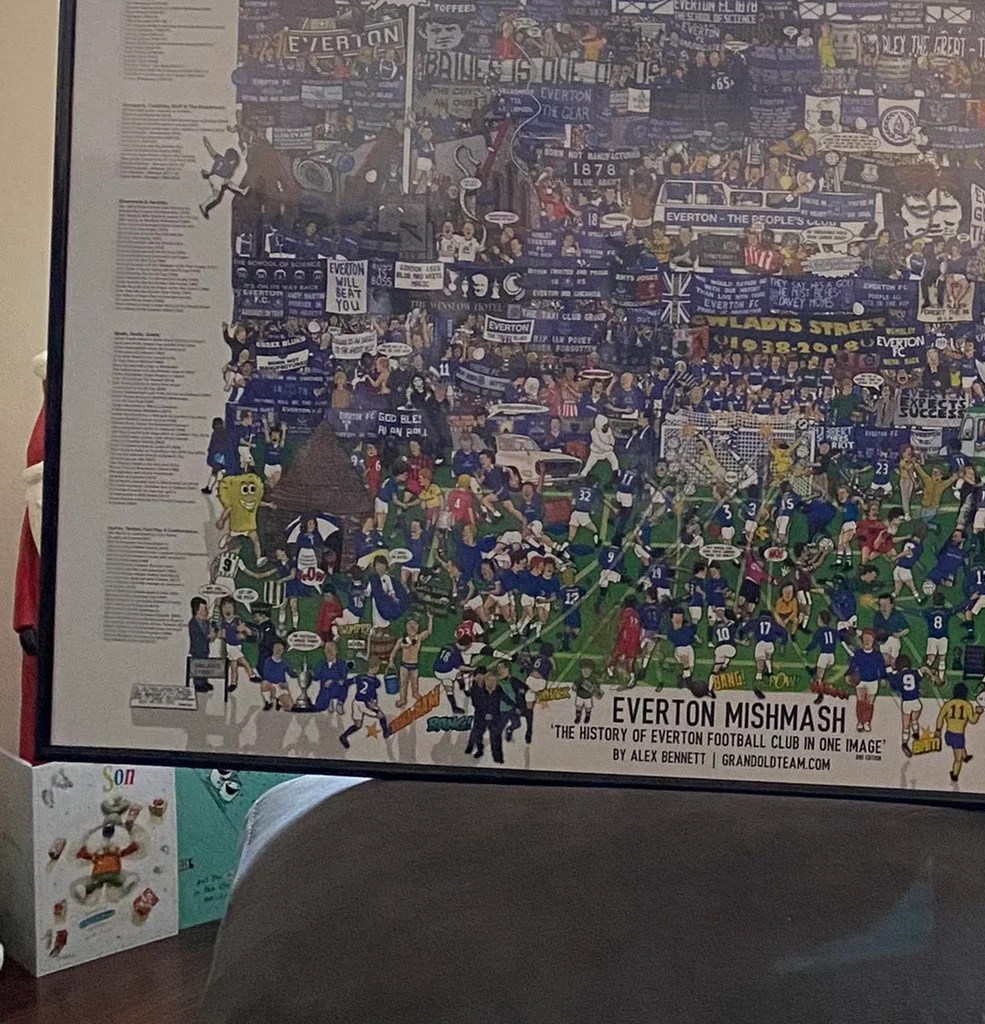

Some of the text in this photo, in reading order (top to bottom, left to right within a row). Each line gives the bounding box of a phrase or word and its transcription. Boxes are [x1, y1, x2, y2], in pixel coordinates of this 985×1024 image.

[541, 87, 592, 102] EVERTON
[573, 162, 616, 175] 1878
[588, 212, 598, 226] 18
[666, 211, 804, 226] EVERTON THE PEOPLE'S
[329, 262, 365, 276] EVERTON
[336, 277, 358, 289] WILL
[770, 277, 788, 288] THEY
[863, 282, 897, 291] EVERTON
[336, 289, 362, 300] BEAT
[336, 299, 360, 312] YOU
[704, 298, 760, 309] EVERTON FC
[562, 312, 582, 320] CLUB
[488, 321, 530, 333] EVERTON
[809, 316, 887, 336] STREET
[876, 336, 925, 347] EVERTON
[893, 346, 905, 357] FC
[439, 364, 449, 376] 11
[900, 399, 966, 409] EXPECTS
[379, 412, 396, 422] GOD
[900, 408, 965, 419] SUCCESS
[351, 455, 358, 466] 9
[376, 461, 381, 472] 6
[875, 463, 890, 475] 23
[578, 490, 592, 502] 32
[749, 503, 757, 516] 3
[781, 498, 794, 510] 15
[724, 505, 733, 520] 3
[608, 552, 615, 564] 9
[223, 558, 232, 572] 9
[760, 621, 771, 635] 17
[933, 616, 943, 630] 8
[716, 627, 731, 642] 10
[824, 631, 833, 644] 11
[440, 650, 450, 662] 18
[534, 659, 541, 668] 6
[360, 681, 368, 694] 2
[903, 673, 915, 691] 9
[613, 696, 846, 733] EVERTON MISHMASH
[950, 704, 965, 720] 11
[580, 726, 627, 742] HISTORY
[632, 728, 646, 742] OF
[651, 729, 703, 746] EVERTON
[707, 732, 766, 748] FOOTBALL
[771, 734, 800, 750] CLUB
[804, 736, 815, 751] IN
[819, 737, 841, 752] ONE
[612, 748, 831, 771] BY ALEX BENNETT GRANDOLDTEAM.COM
[103, 766, 135, 792] Son
